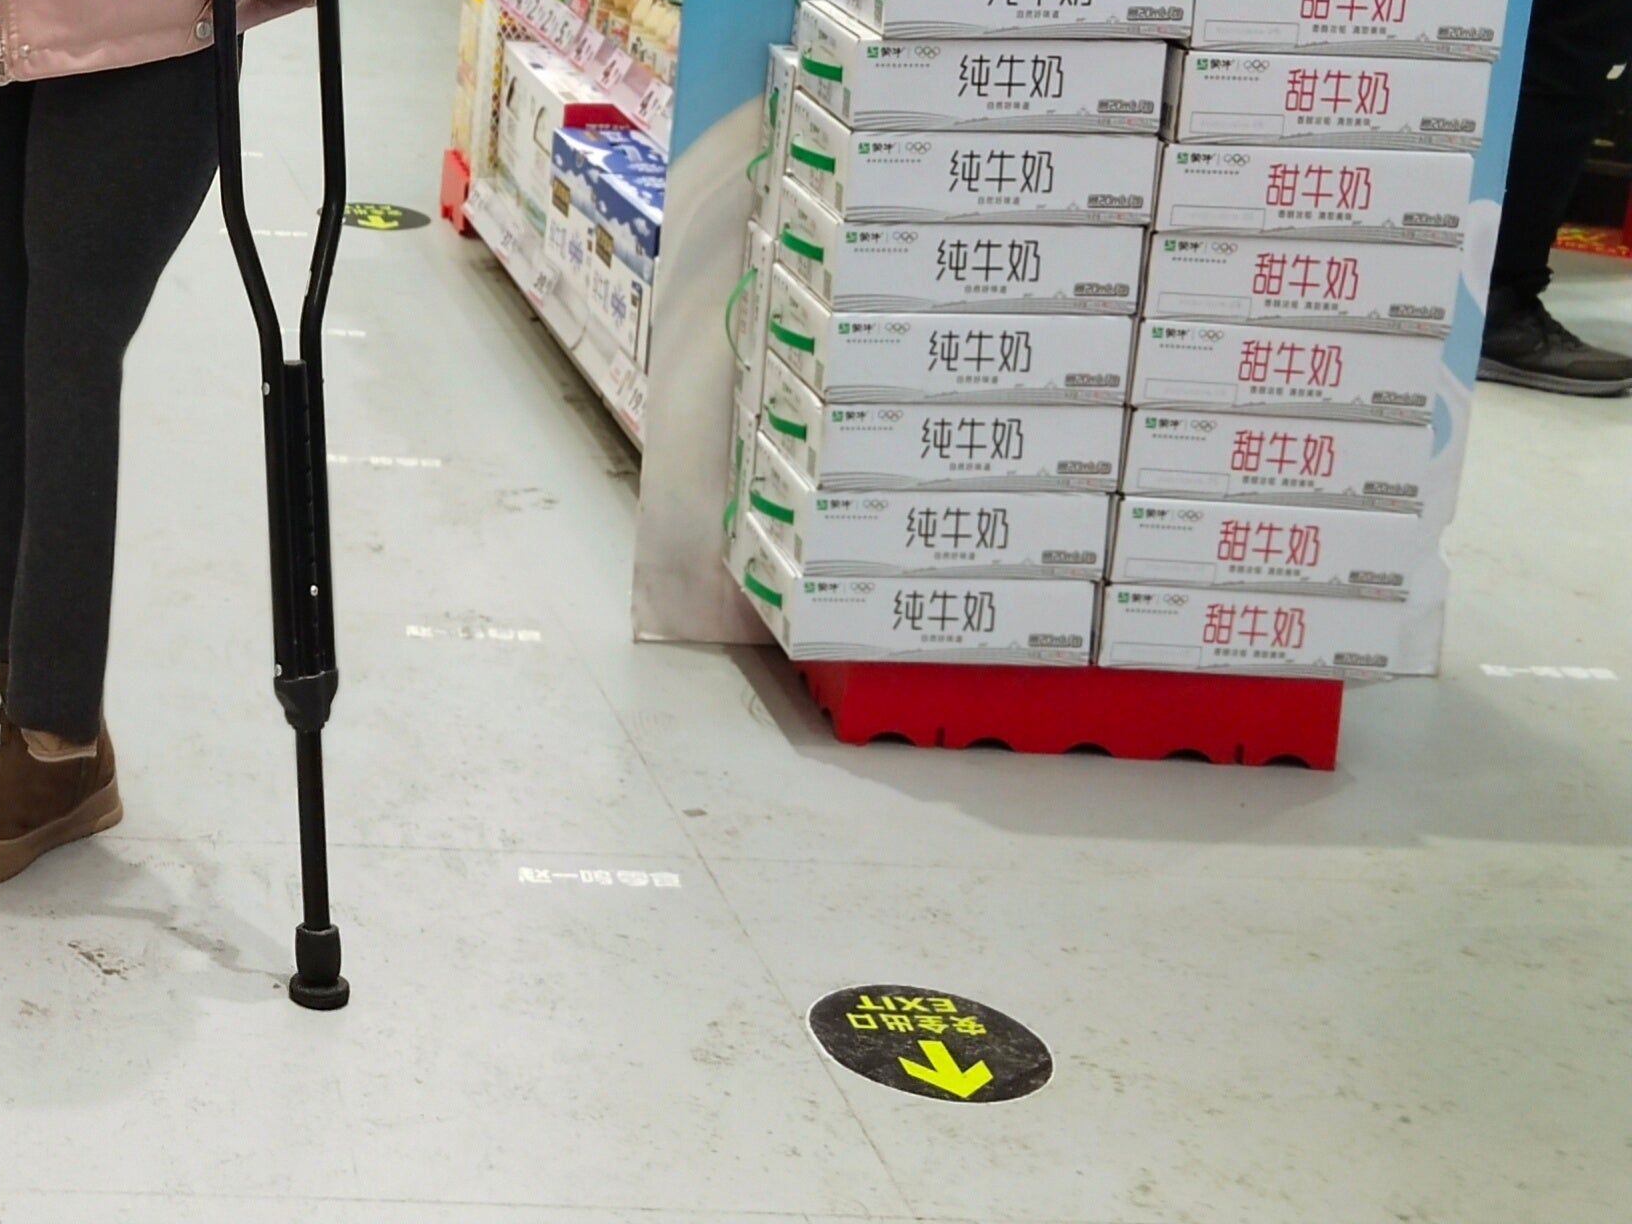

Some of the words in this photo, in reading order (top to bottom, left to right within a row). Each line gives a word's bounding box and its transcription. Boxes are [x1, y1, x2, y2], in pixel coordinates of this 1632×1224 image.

[958, 54, 1064, 98] 纯牛奶
[1285, 69, 1390, 115] 甜牛奶
[949, 150, 1054, 193] 纯牛奶
[1266, 164, 1371, 210] 甜牛奶
[936, 239, 1041, 283] 纯牛奶
[1252, 252, 1358, 300] 甜牛奶
[928, 329, 1032, 372] 纯牛奶
[1238, 339, 1343, 387] 甜牛奶
[921, 417, 1023, 459] 纯牛奶
[1231, 429, 1334, 477] 甜牛奶
[906, 507, 1009, 549] 纯牛奶
[1217, 519, 1320, 566] 甜牛奶
[893, 589, 995, 632] 纯牛奶
[1203, 603, 1305, 649] 甜牛奶
[846, 1013, 987, 1036] 安全出口
[856, 995, 958, 1013] EXIT
